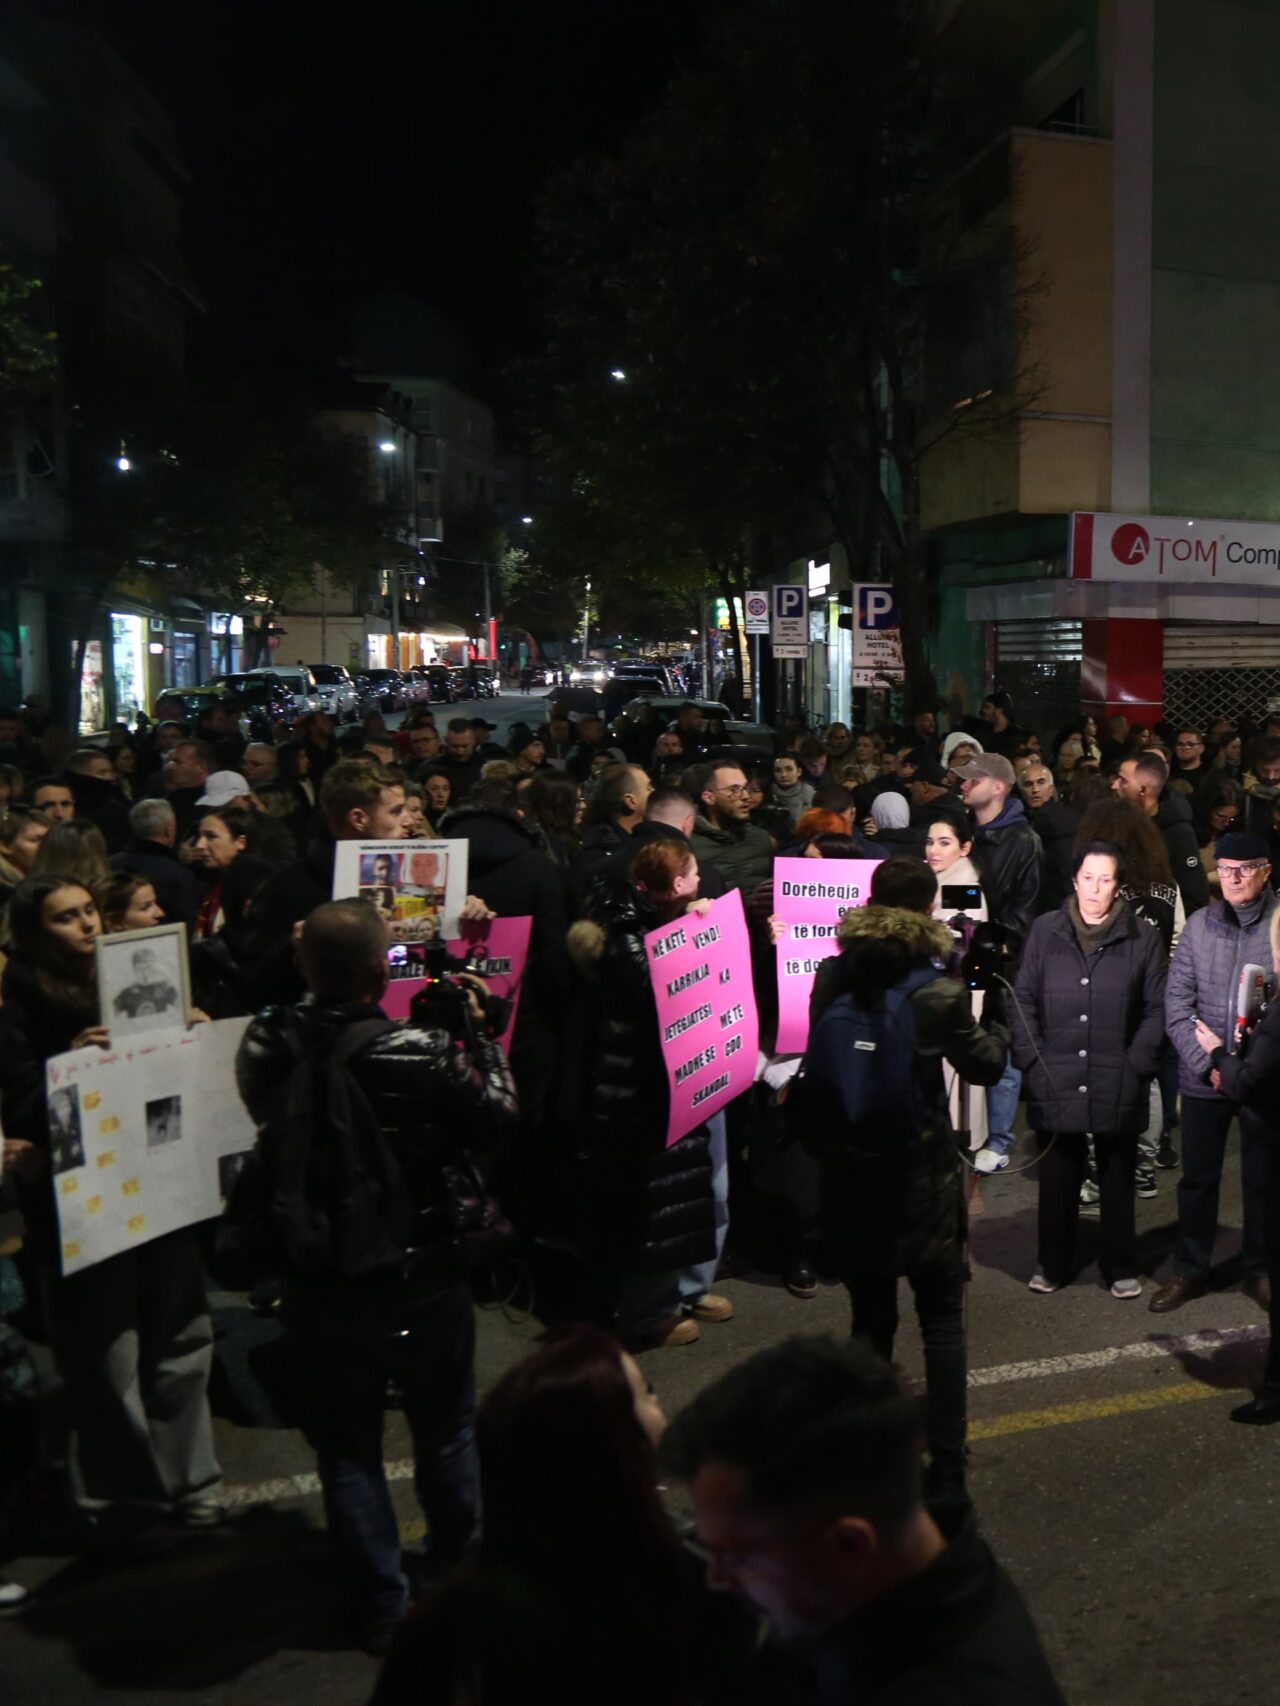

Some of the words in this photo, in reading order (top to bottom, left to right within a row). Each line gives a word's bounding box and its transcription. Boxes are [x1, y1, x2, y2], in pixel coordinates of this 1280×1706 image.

[1126, 535, 1218, 577] ATOM
[781, 589, 800, 616] P
[866, 590, 894, 627] P
[782, 881, 859, 899] Dorëheqja
[692, 925, 721, 950] VEND!
[794, 924, 809, 939] të
[719, 968, 730, 984] KA
[786, 960, 800, 974] të
[675, 1053, 704, 1084] MADHE
[705, 1045, 715, 1062] SE
[693, 1073, 729, 1106] SKANDAL
